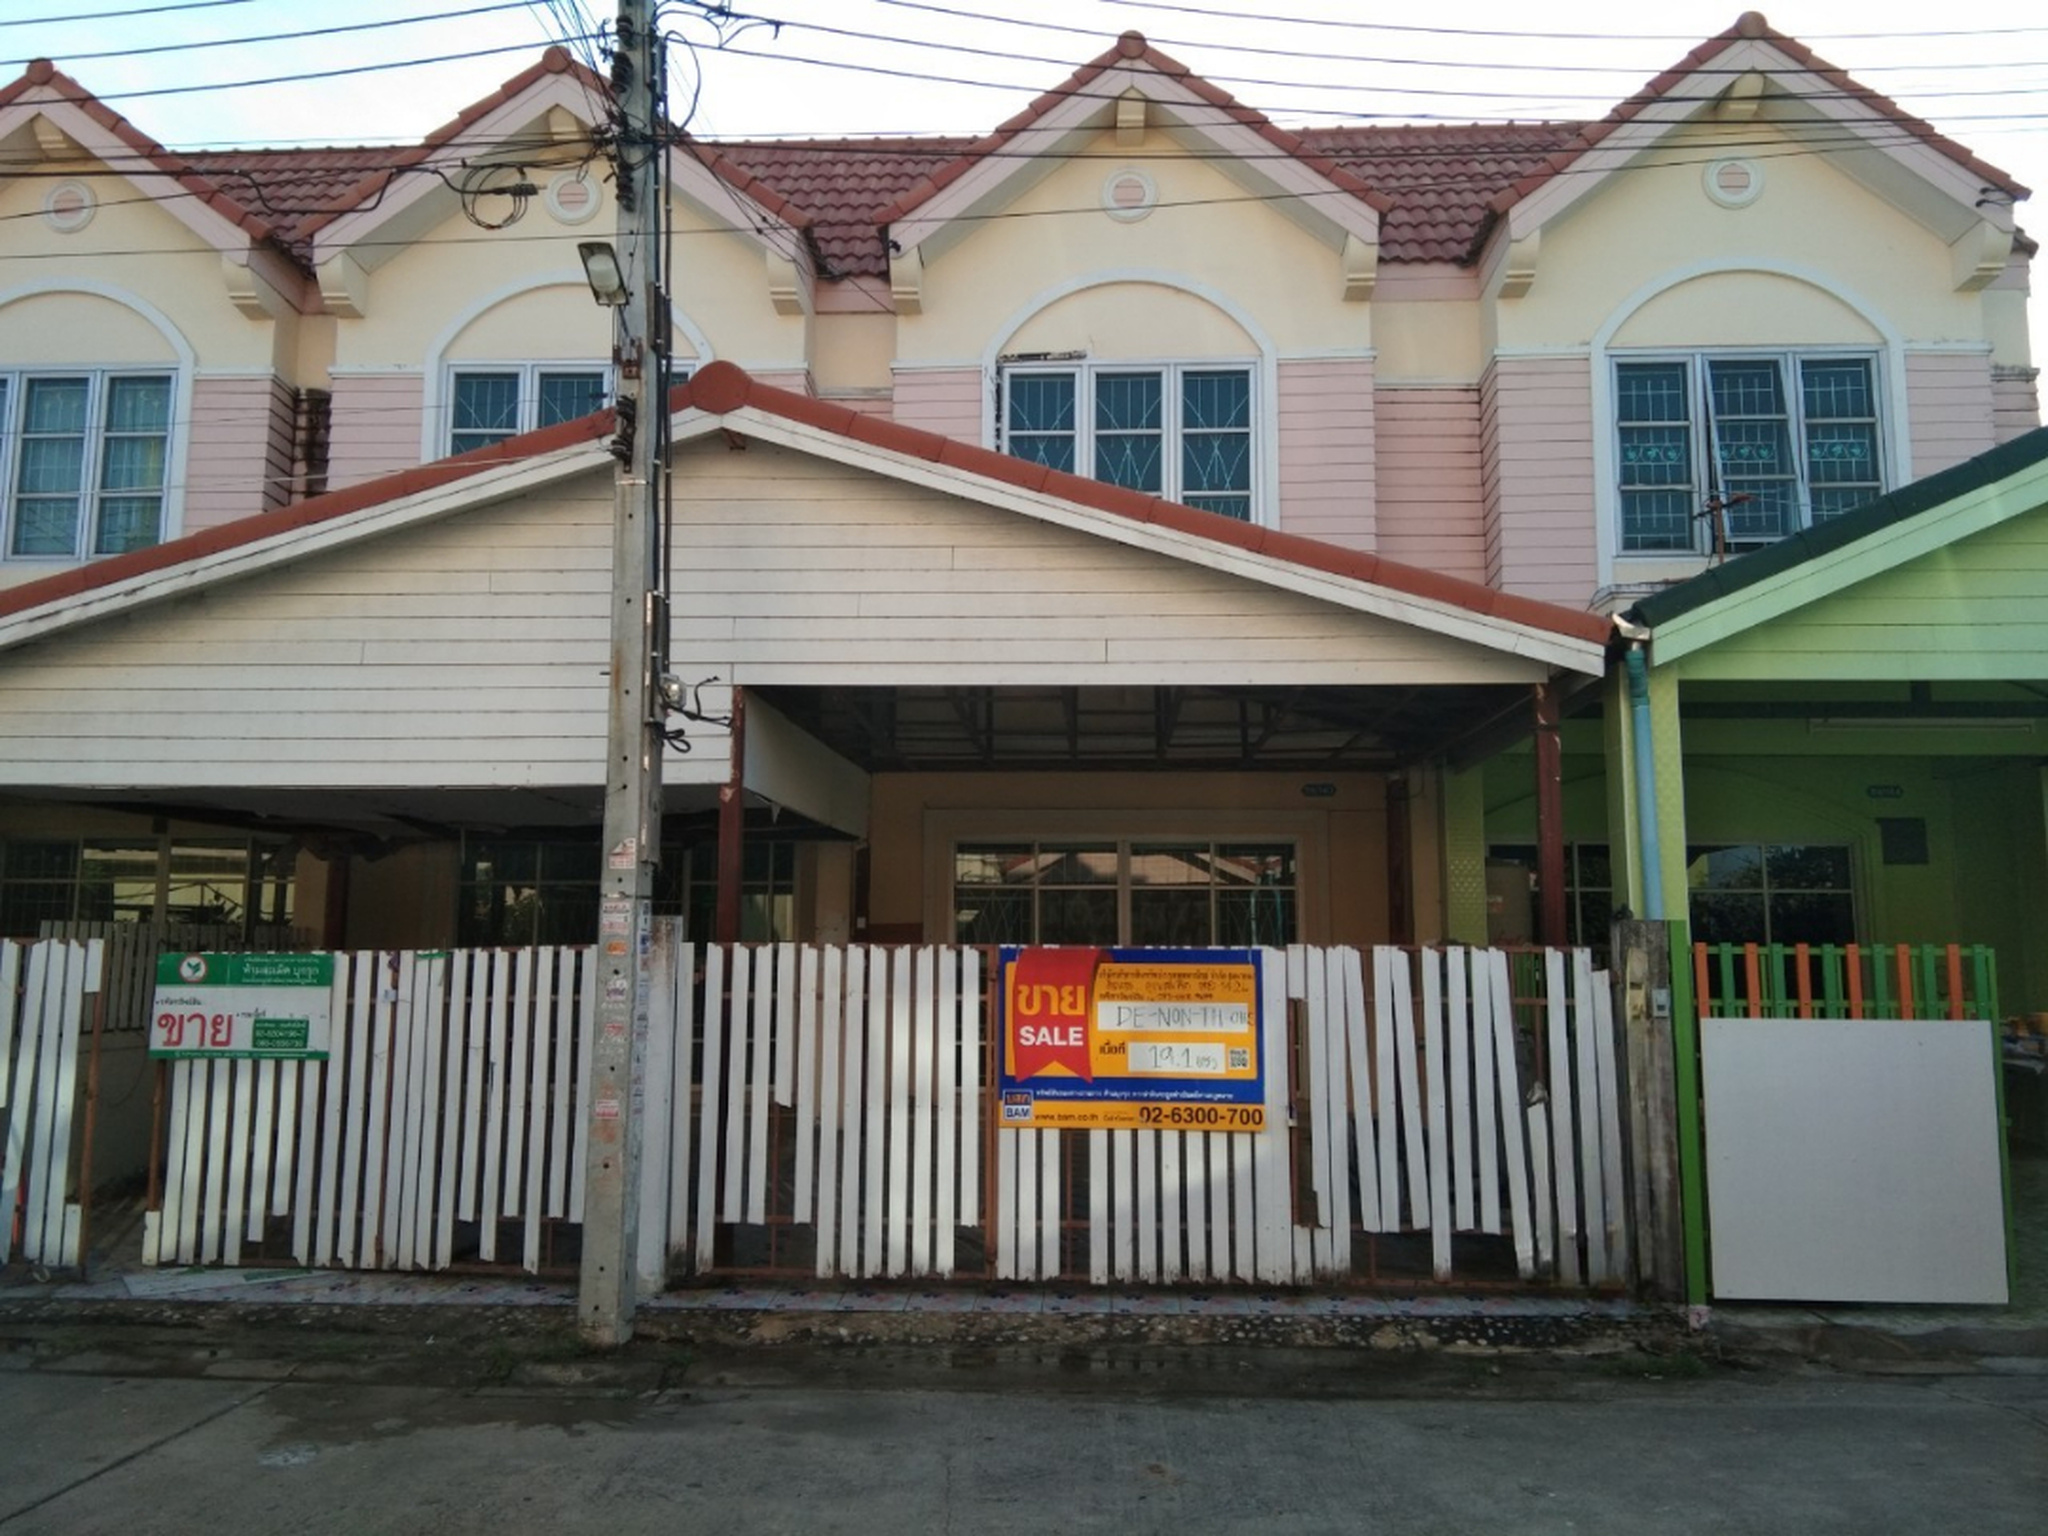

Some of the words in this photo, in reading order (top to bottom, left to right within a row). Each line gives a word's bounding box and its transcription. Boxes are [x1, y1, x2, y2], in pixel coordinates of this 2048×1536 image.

[1018, 985, 1085, 1016] ขาย
[157, 1012, 233, 1049] ขาย
[1019, 1026, 1084, 1046] SALE
[1006, 1106, 1030, 1118] BAM
[1138, 1105, 1264, 1126] 02-6300-700
